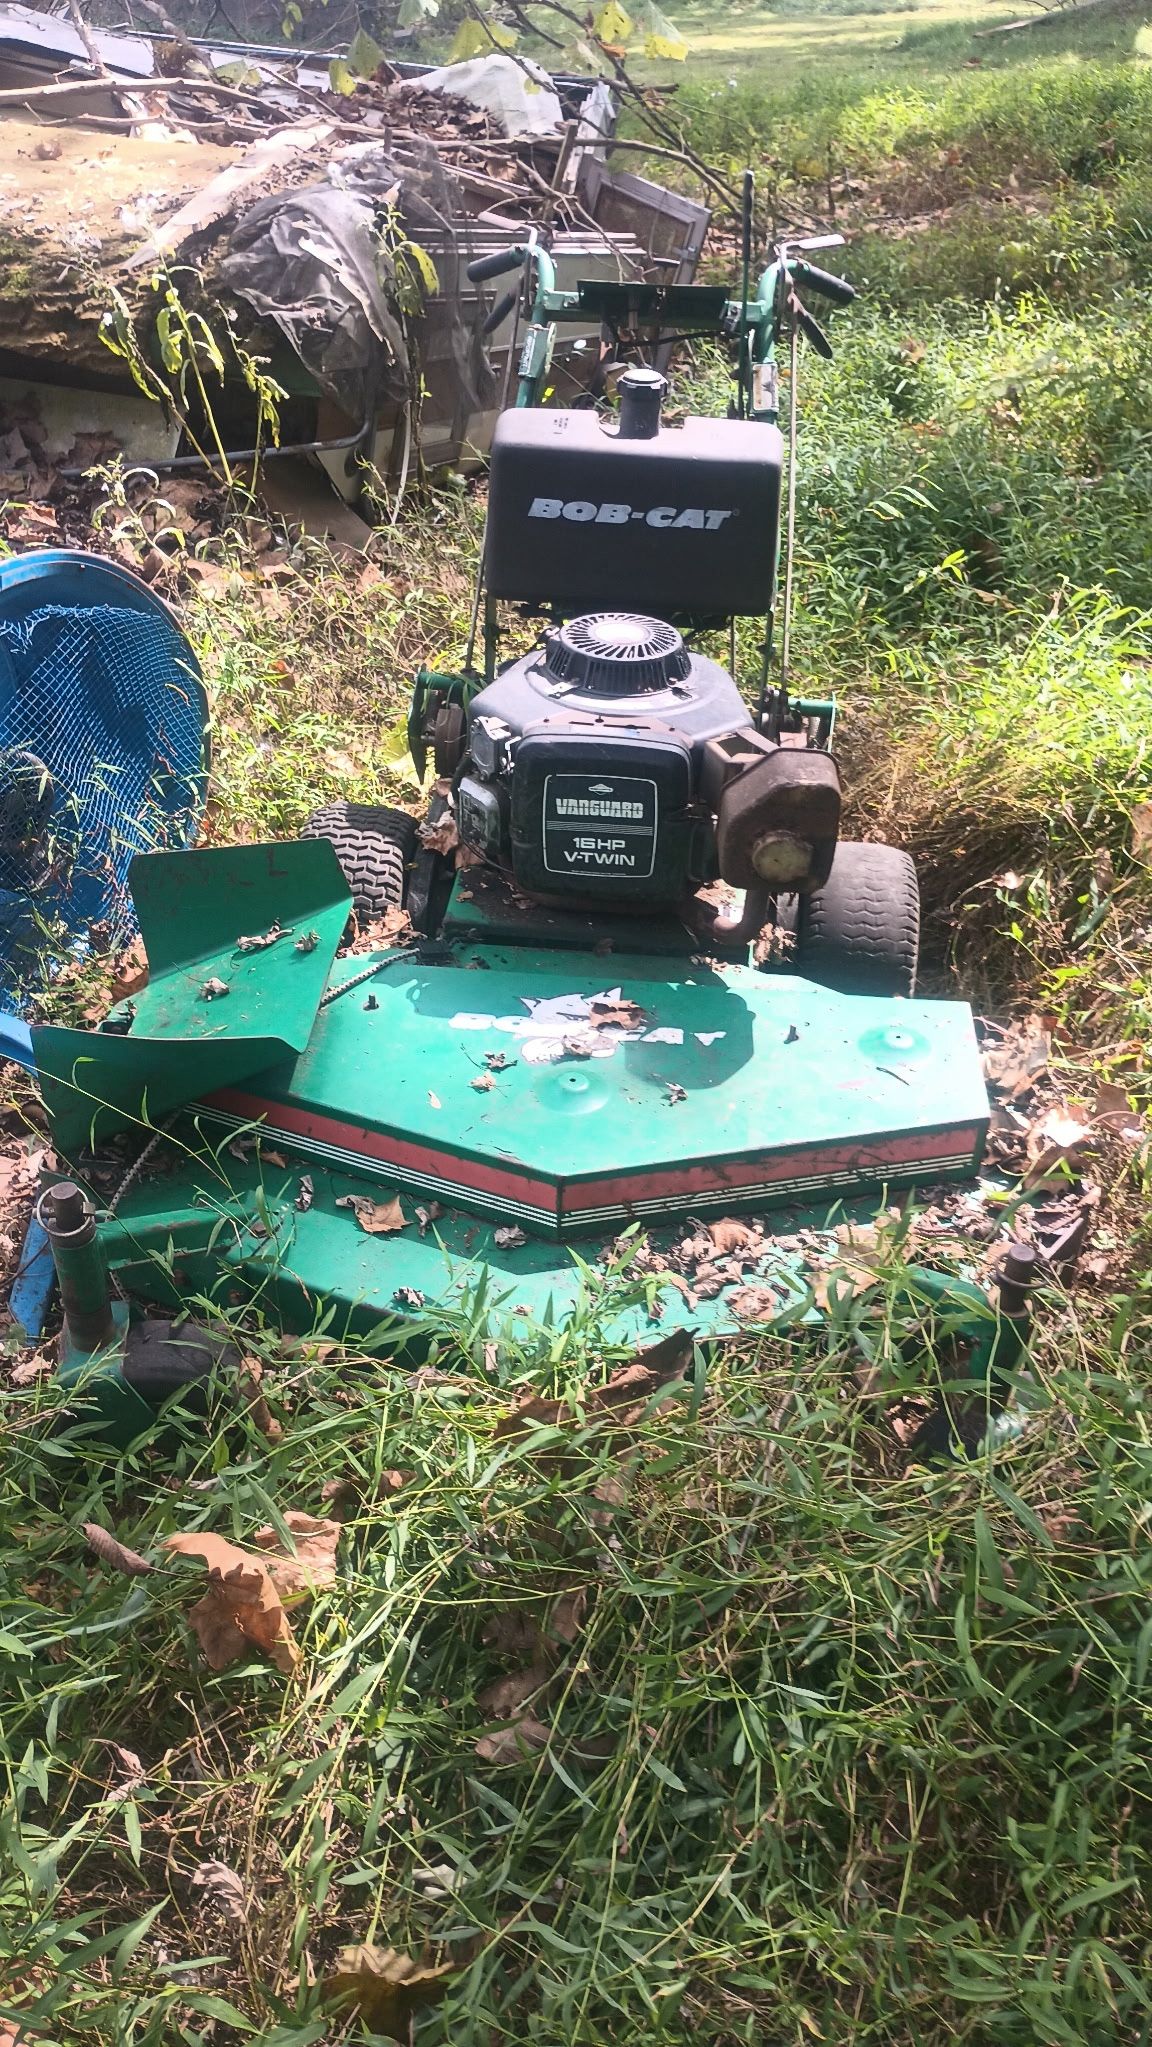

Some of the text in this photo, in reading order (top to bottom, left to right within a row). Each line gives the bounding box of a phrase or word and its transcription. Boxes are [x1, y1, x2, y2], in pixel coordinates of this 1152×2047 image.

[527, 498, 733, 530] BOB-CAT
[555, 798, 644, 819] VANGUARD
[563, 850, 635, 867] V-TWIN
